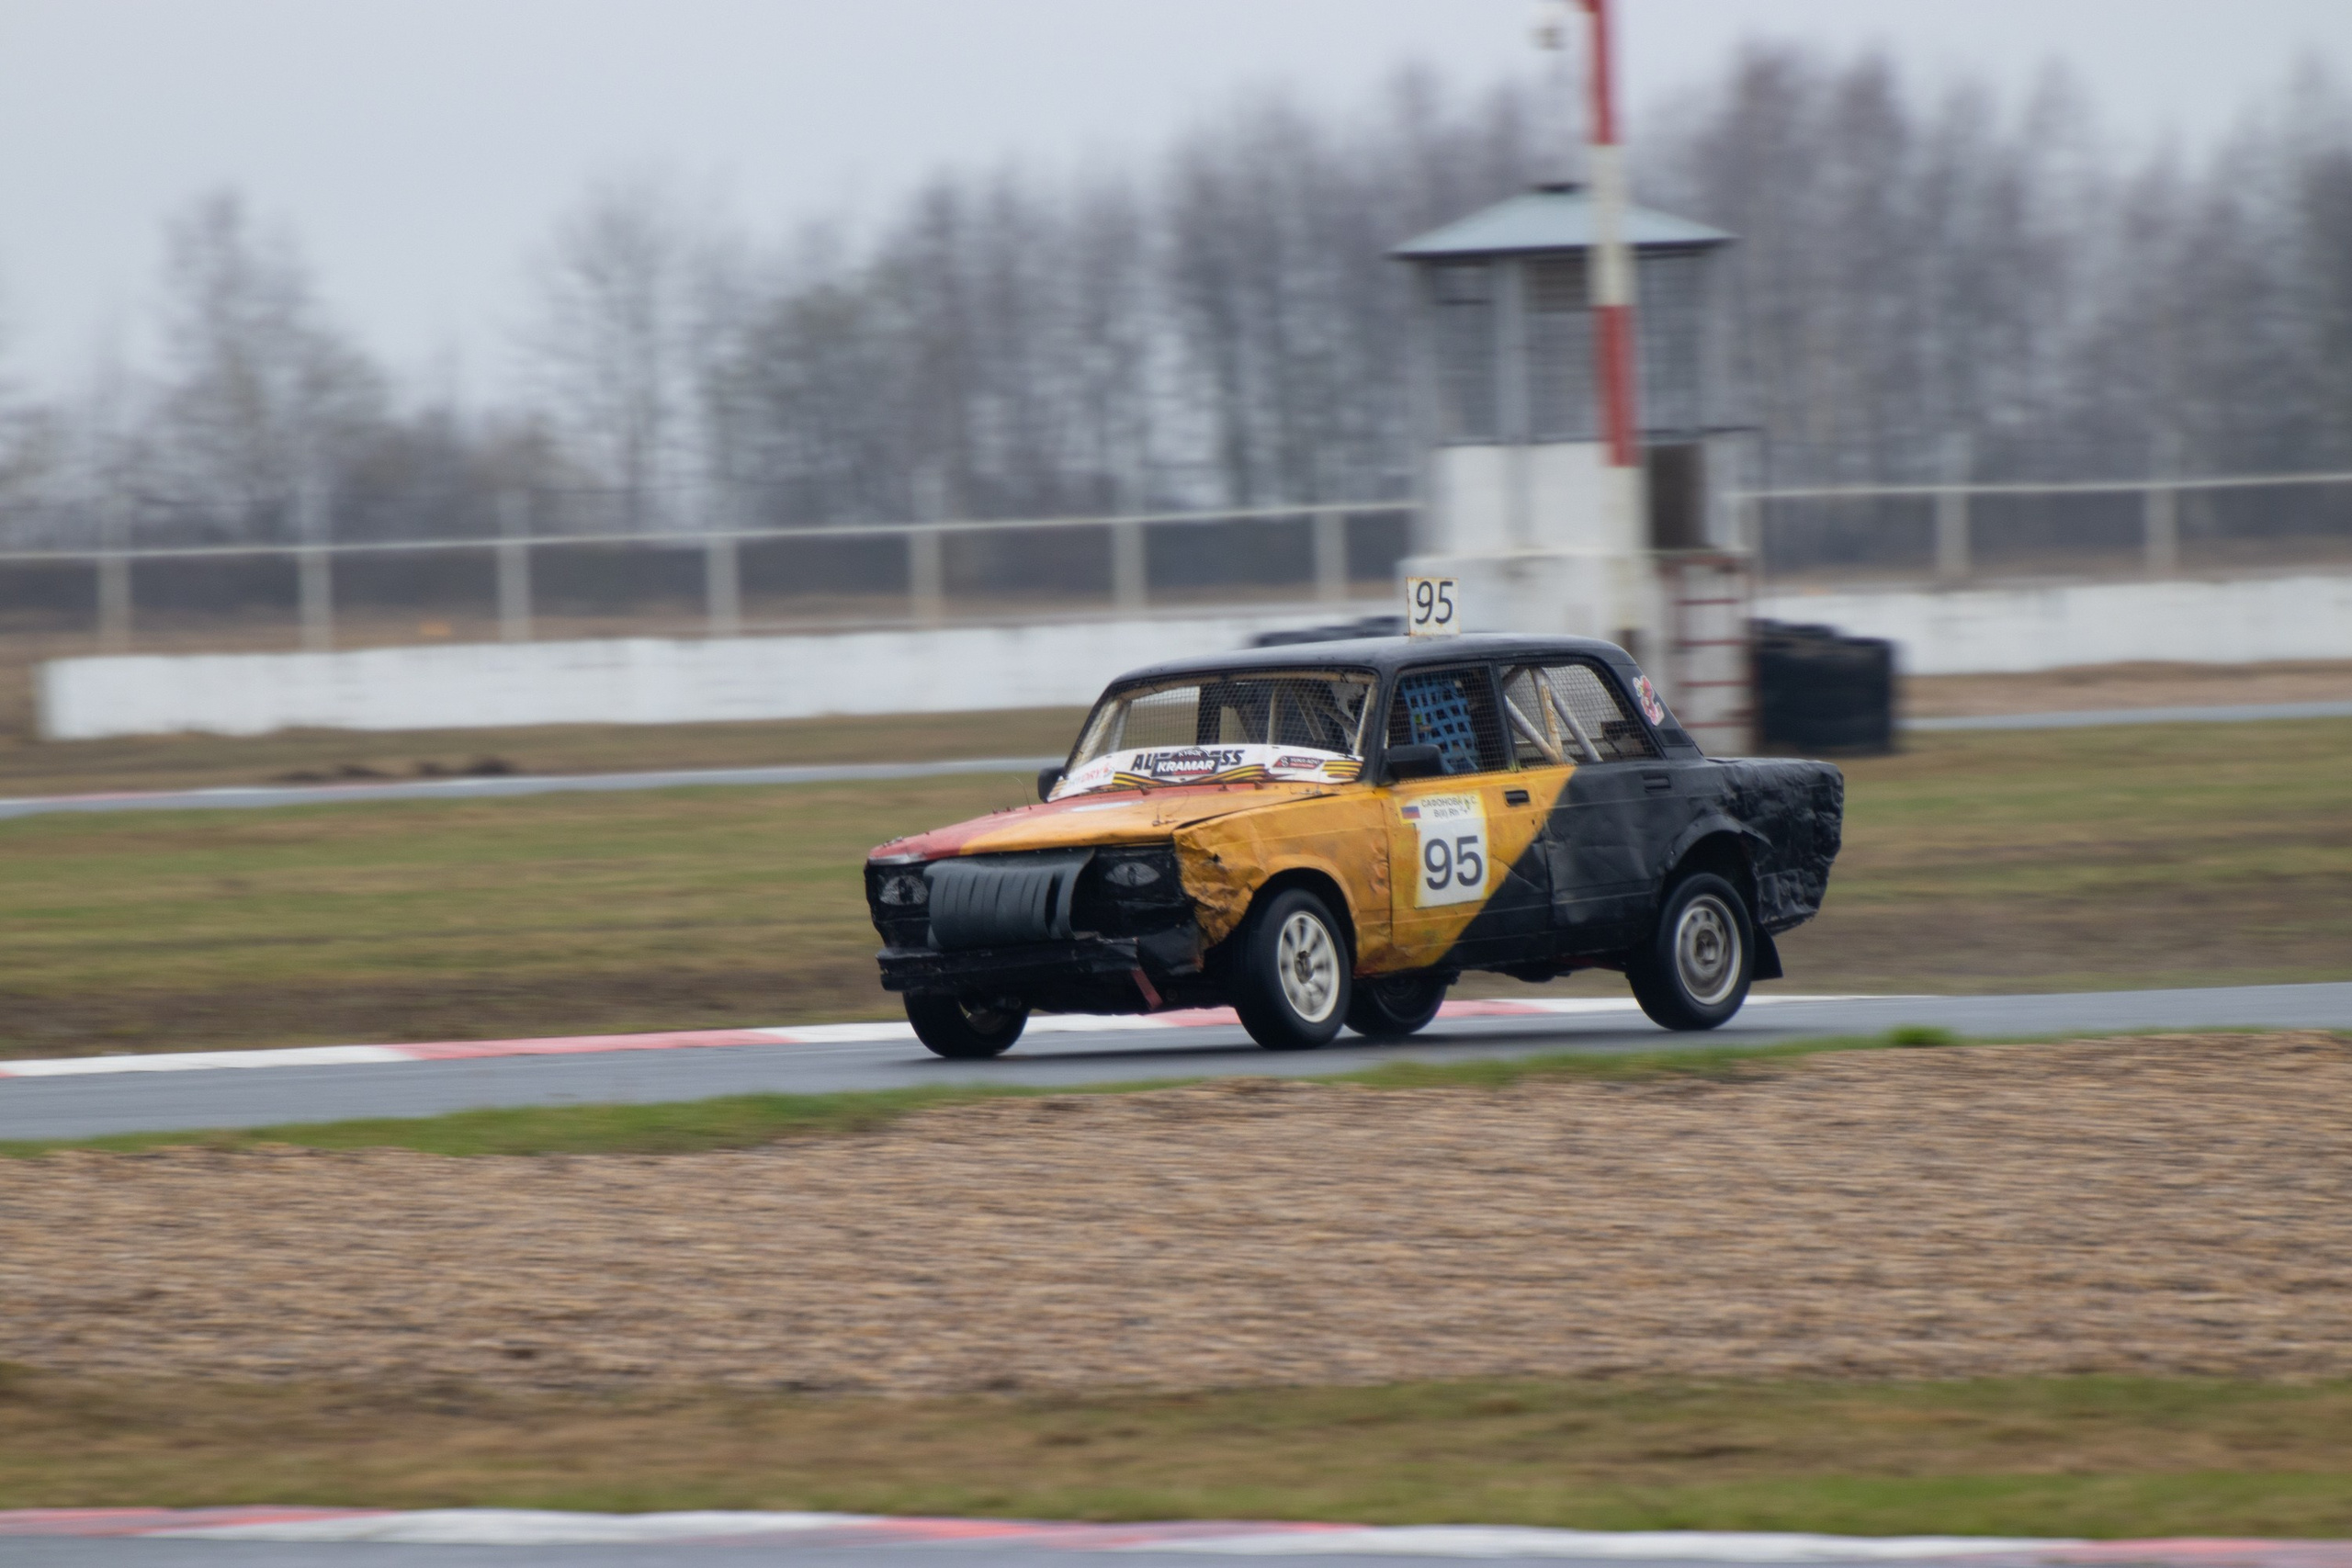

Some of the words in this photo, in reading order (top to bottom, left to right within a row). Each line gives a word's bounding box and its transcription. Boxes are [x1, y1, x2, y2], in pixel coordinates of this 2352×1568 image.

[1415, 581, 1453, 625] 95
[1156, 760, 1216, 773] KRAMAR
[1424, 835, 1484, 890] 95
